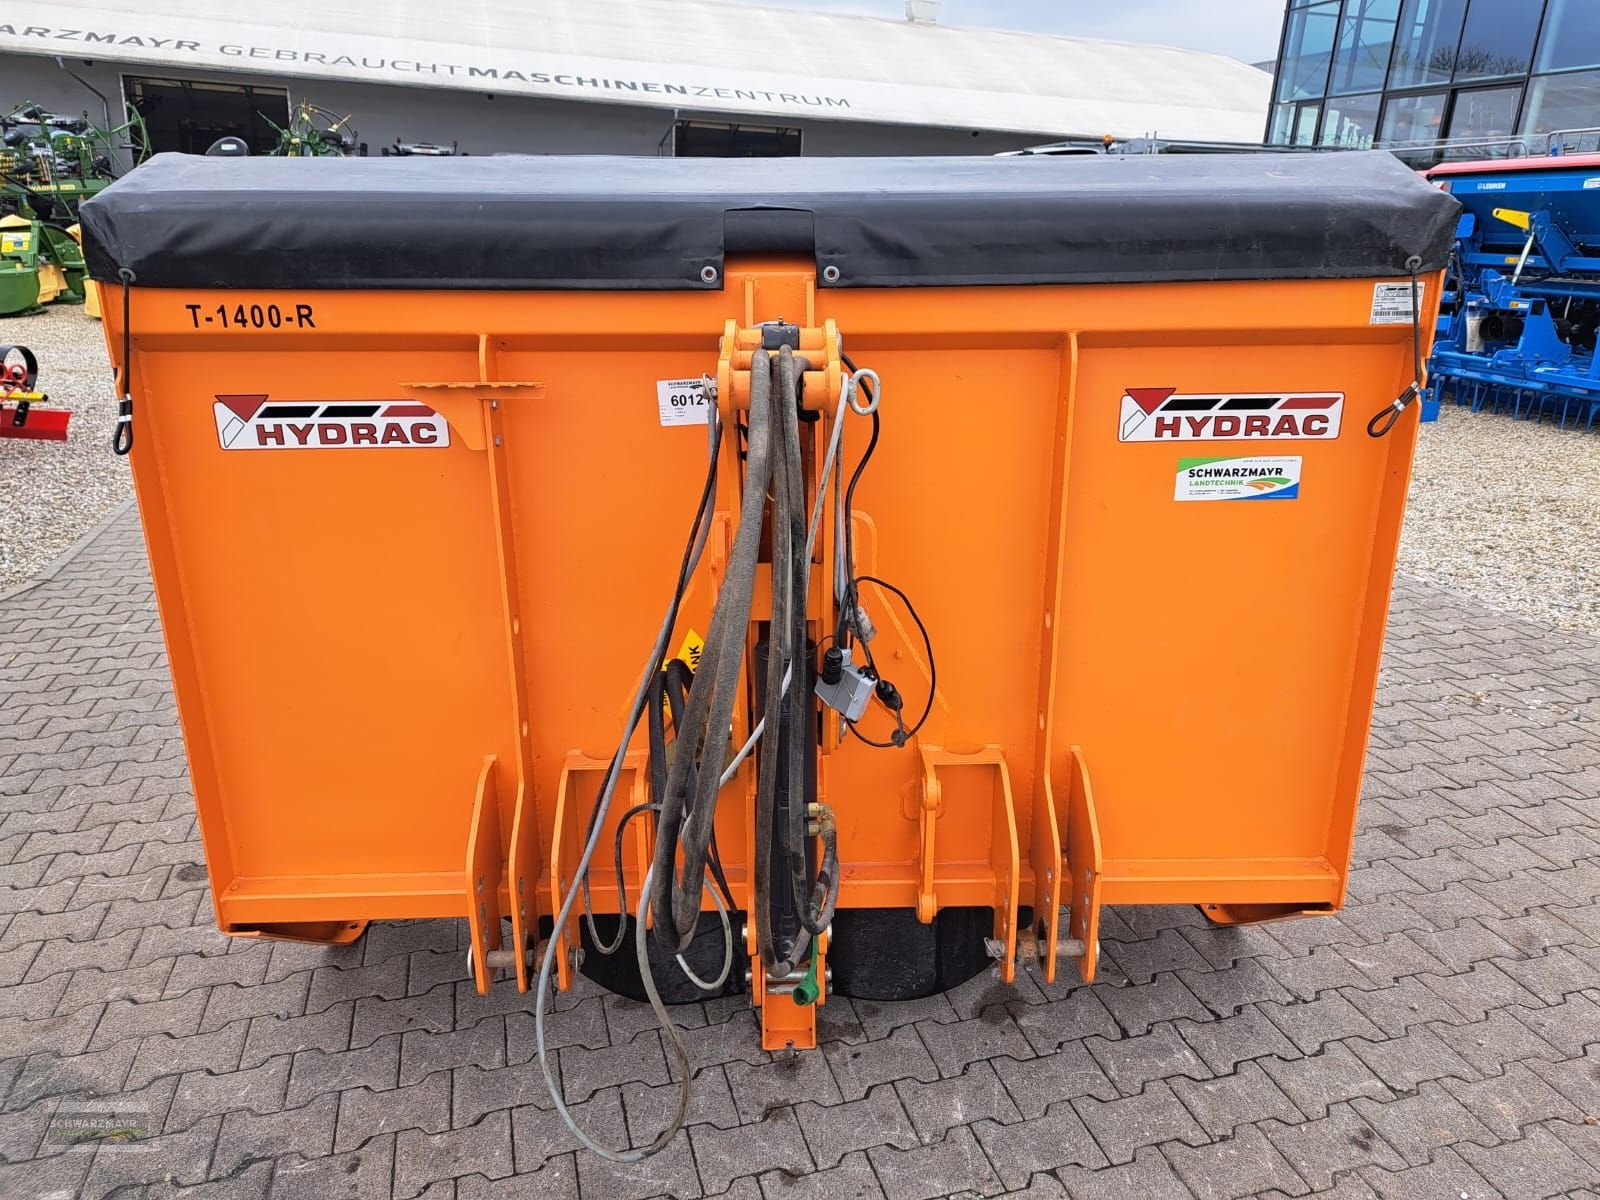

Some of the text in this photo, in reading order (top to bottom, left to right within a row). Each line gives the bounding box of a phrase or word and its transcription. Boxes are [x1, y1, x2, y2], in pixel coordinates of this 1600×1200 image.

[185, 304, 316, 328] T-1400-R
[256, 422, 438, 446] HYDRAC
[1154, 414, 1330, 438] HYDRAC
[1188, 467, 1283, 478] SCHWARZMAYR
[1189, 479, 1244, 487] LANDTECHNIK
